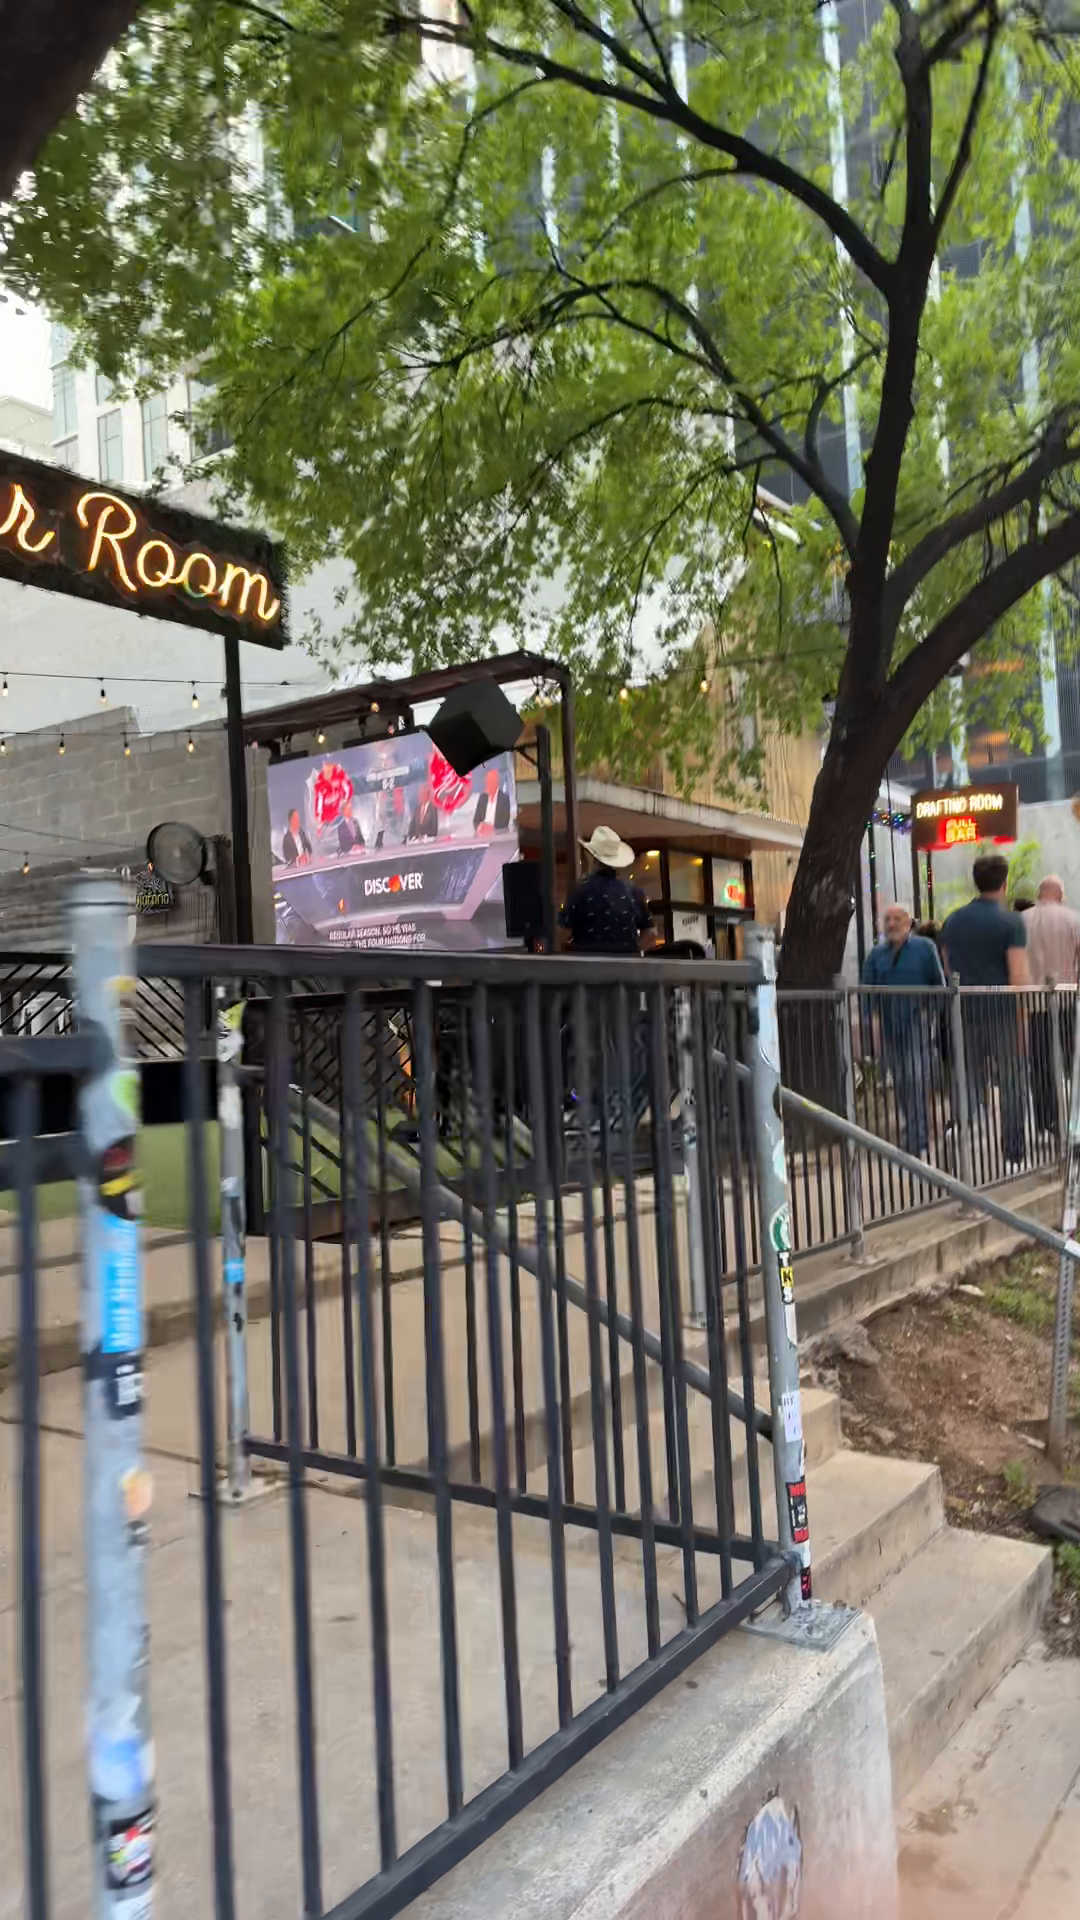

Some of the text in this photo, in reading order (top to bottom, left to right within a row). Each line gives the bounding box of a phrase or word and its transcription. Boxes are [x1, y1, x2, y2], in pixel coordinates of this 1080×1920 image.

[77, 491, 281, 621] Room
[969, 793, 1004, 812] ROOM
[945, 827, 977, 843] BAR
[364, 872, 423, 896] DISCOVER
